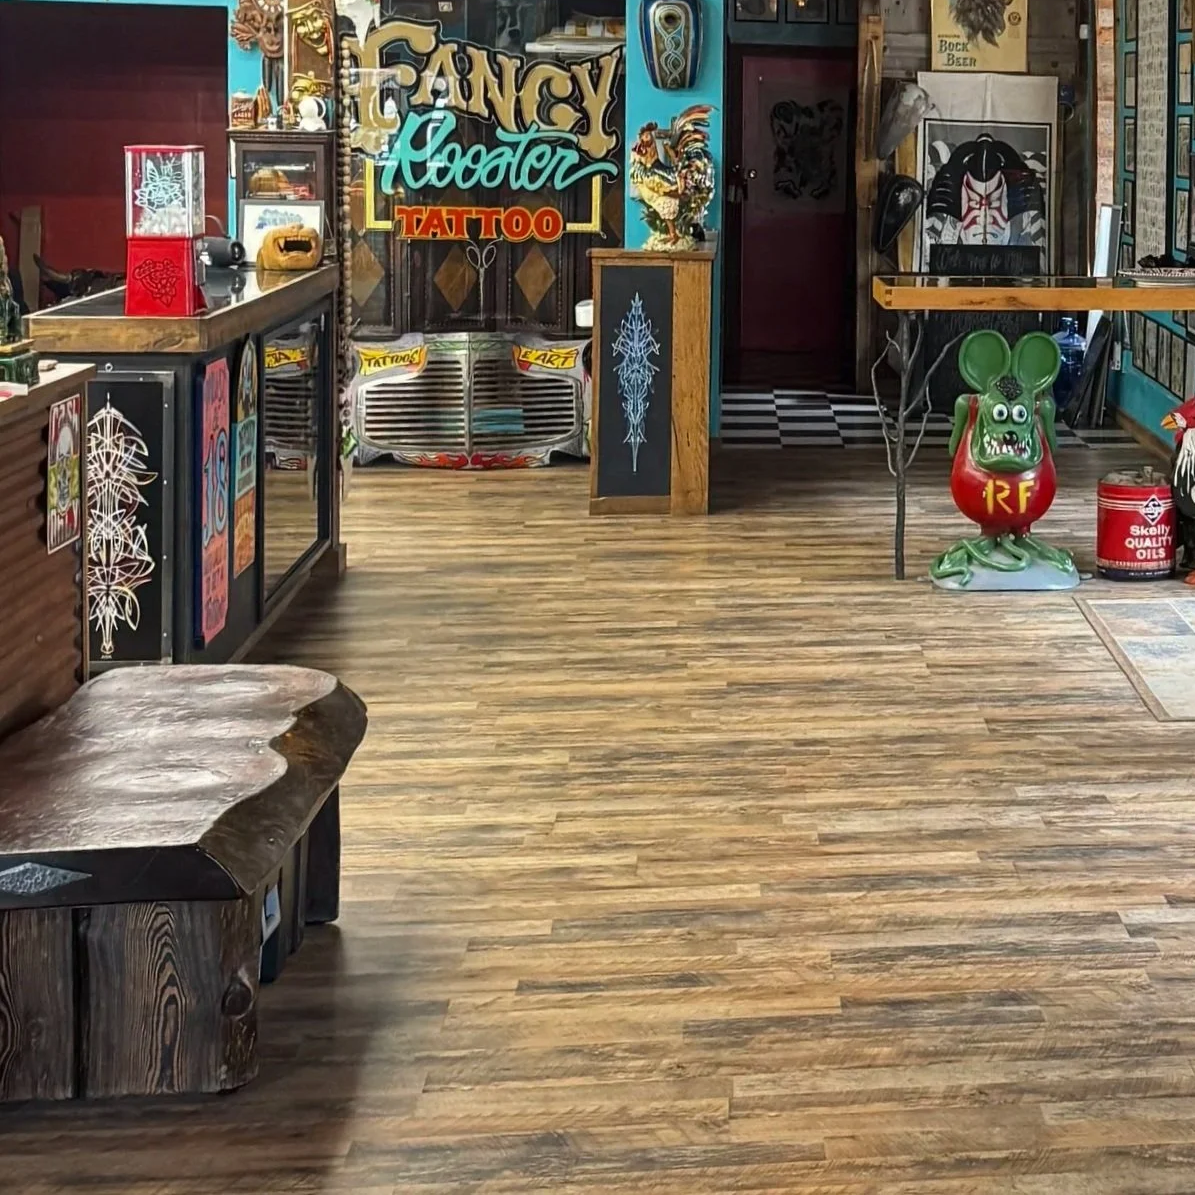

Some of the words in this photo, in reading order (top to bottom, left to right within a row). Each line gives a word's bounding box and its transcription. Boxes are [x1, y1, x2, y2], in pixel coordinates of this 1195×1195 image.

[938, 39, 970, 53] BOCK
[943, 53, 977, 67] BEER
[341, 18, 623, 158] FANCY
[381, 111, 618, 194] Rooster
[395, 205, 564, 241] TATTOO
[366, 350, 419, 367] TATTOOS
[535, 352, 574, 367] ART
[202, 428, 229, 548] 18
[1129, 525, 1170, 537] Skelly
[1124, 536, 1173, 549] QUALITY
[1135, 548, 1166, 559] OILS
